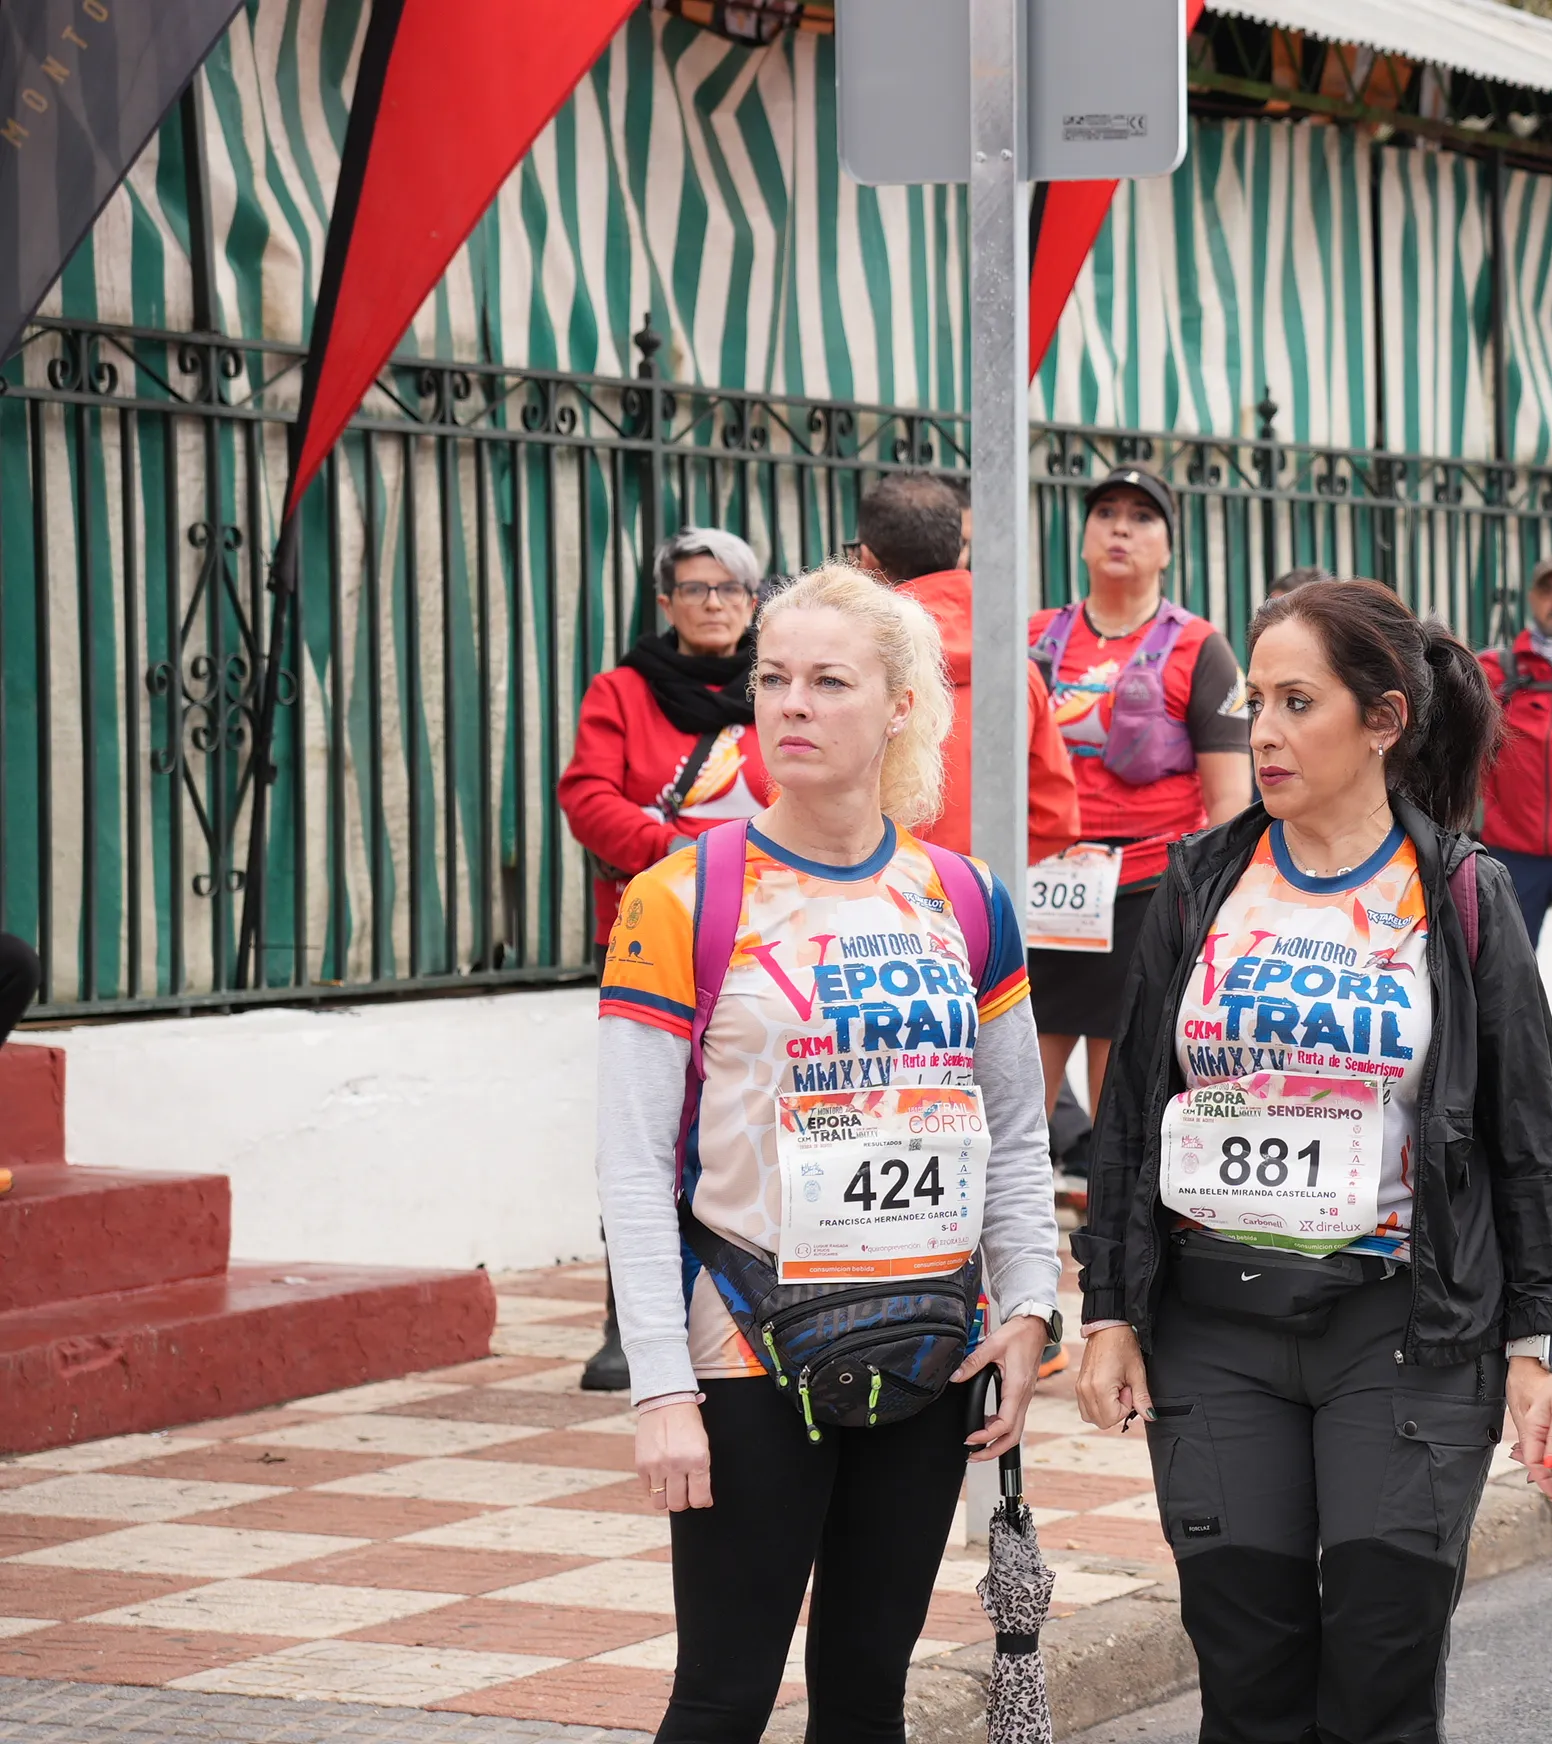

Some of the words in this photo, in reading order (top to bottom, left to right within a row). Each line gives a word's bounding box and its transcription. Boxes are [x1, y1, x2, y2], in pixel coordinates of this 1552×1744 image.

[1030, 881, 1087, 909] 308
[840, 932, 923, 959] MONTORO
[1271, 936, 1358, 968] MONTORO
[740, 933, 837, 1022] V
[811, 958, 976, 1003] EPORA
[1201, 930, 1277, 1006] V
[1222, 956, 1411, 1009] EPORA
[1184, 1019, 1223, 1041] CXM
[1219, 993, 1414, 1061] TRAIL
[786, 1035, 833, 1059] CXM
[1186, 1044, 1286, 1077] MMXXV
[1297, 1050, 1324, 1066] Ruta
[1328, 1053, 1341, 1069] de
[1344, 1057, 1405, 1079] Senderismo
[792, 1055, 892, 1093] MMXXV
[936, 1102, 971, 1114] TRAIL
[1194, 1090, 1246, 1106] EPORA
[807, 1113, 862, 1131] EPORA
[909, 1114, 982, 1134] CORTO
[1195, 1103, 1240, 1118] TRAIL
[1267, 1105, 1363, 1120] SENDERISMO
[810, 1127, 856, 1143] TRAIL
[863, 1140, 903, 1148] RESULTADOS
[1218, 1135, 1321, 1188] 881
[843, 1155, 945, 1212] 424
[1178, 1187, 1197, 1195] ANA
[1199, 1188, 1229, 1197] BELEN
[1231, 1188, 1274, 1198] MIRANDA
[1276, 1189, 1337, 1199] CASTELLANO
[819, 1217, 872, 1227] FRANCISCA
[1242, 1217, 1284, 1230] Carbonell
[1316, 1220, 1361, 1233] direlux
[1236, 1234, 1258, 1242] bebida
[809, 1265, 851, 1274] consumicion
[851, 1265, 875, 1273] bebida
[913, 1258, 947, 1270] consumicion
